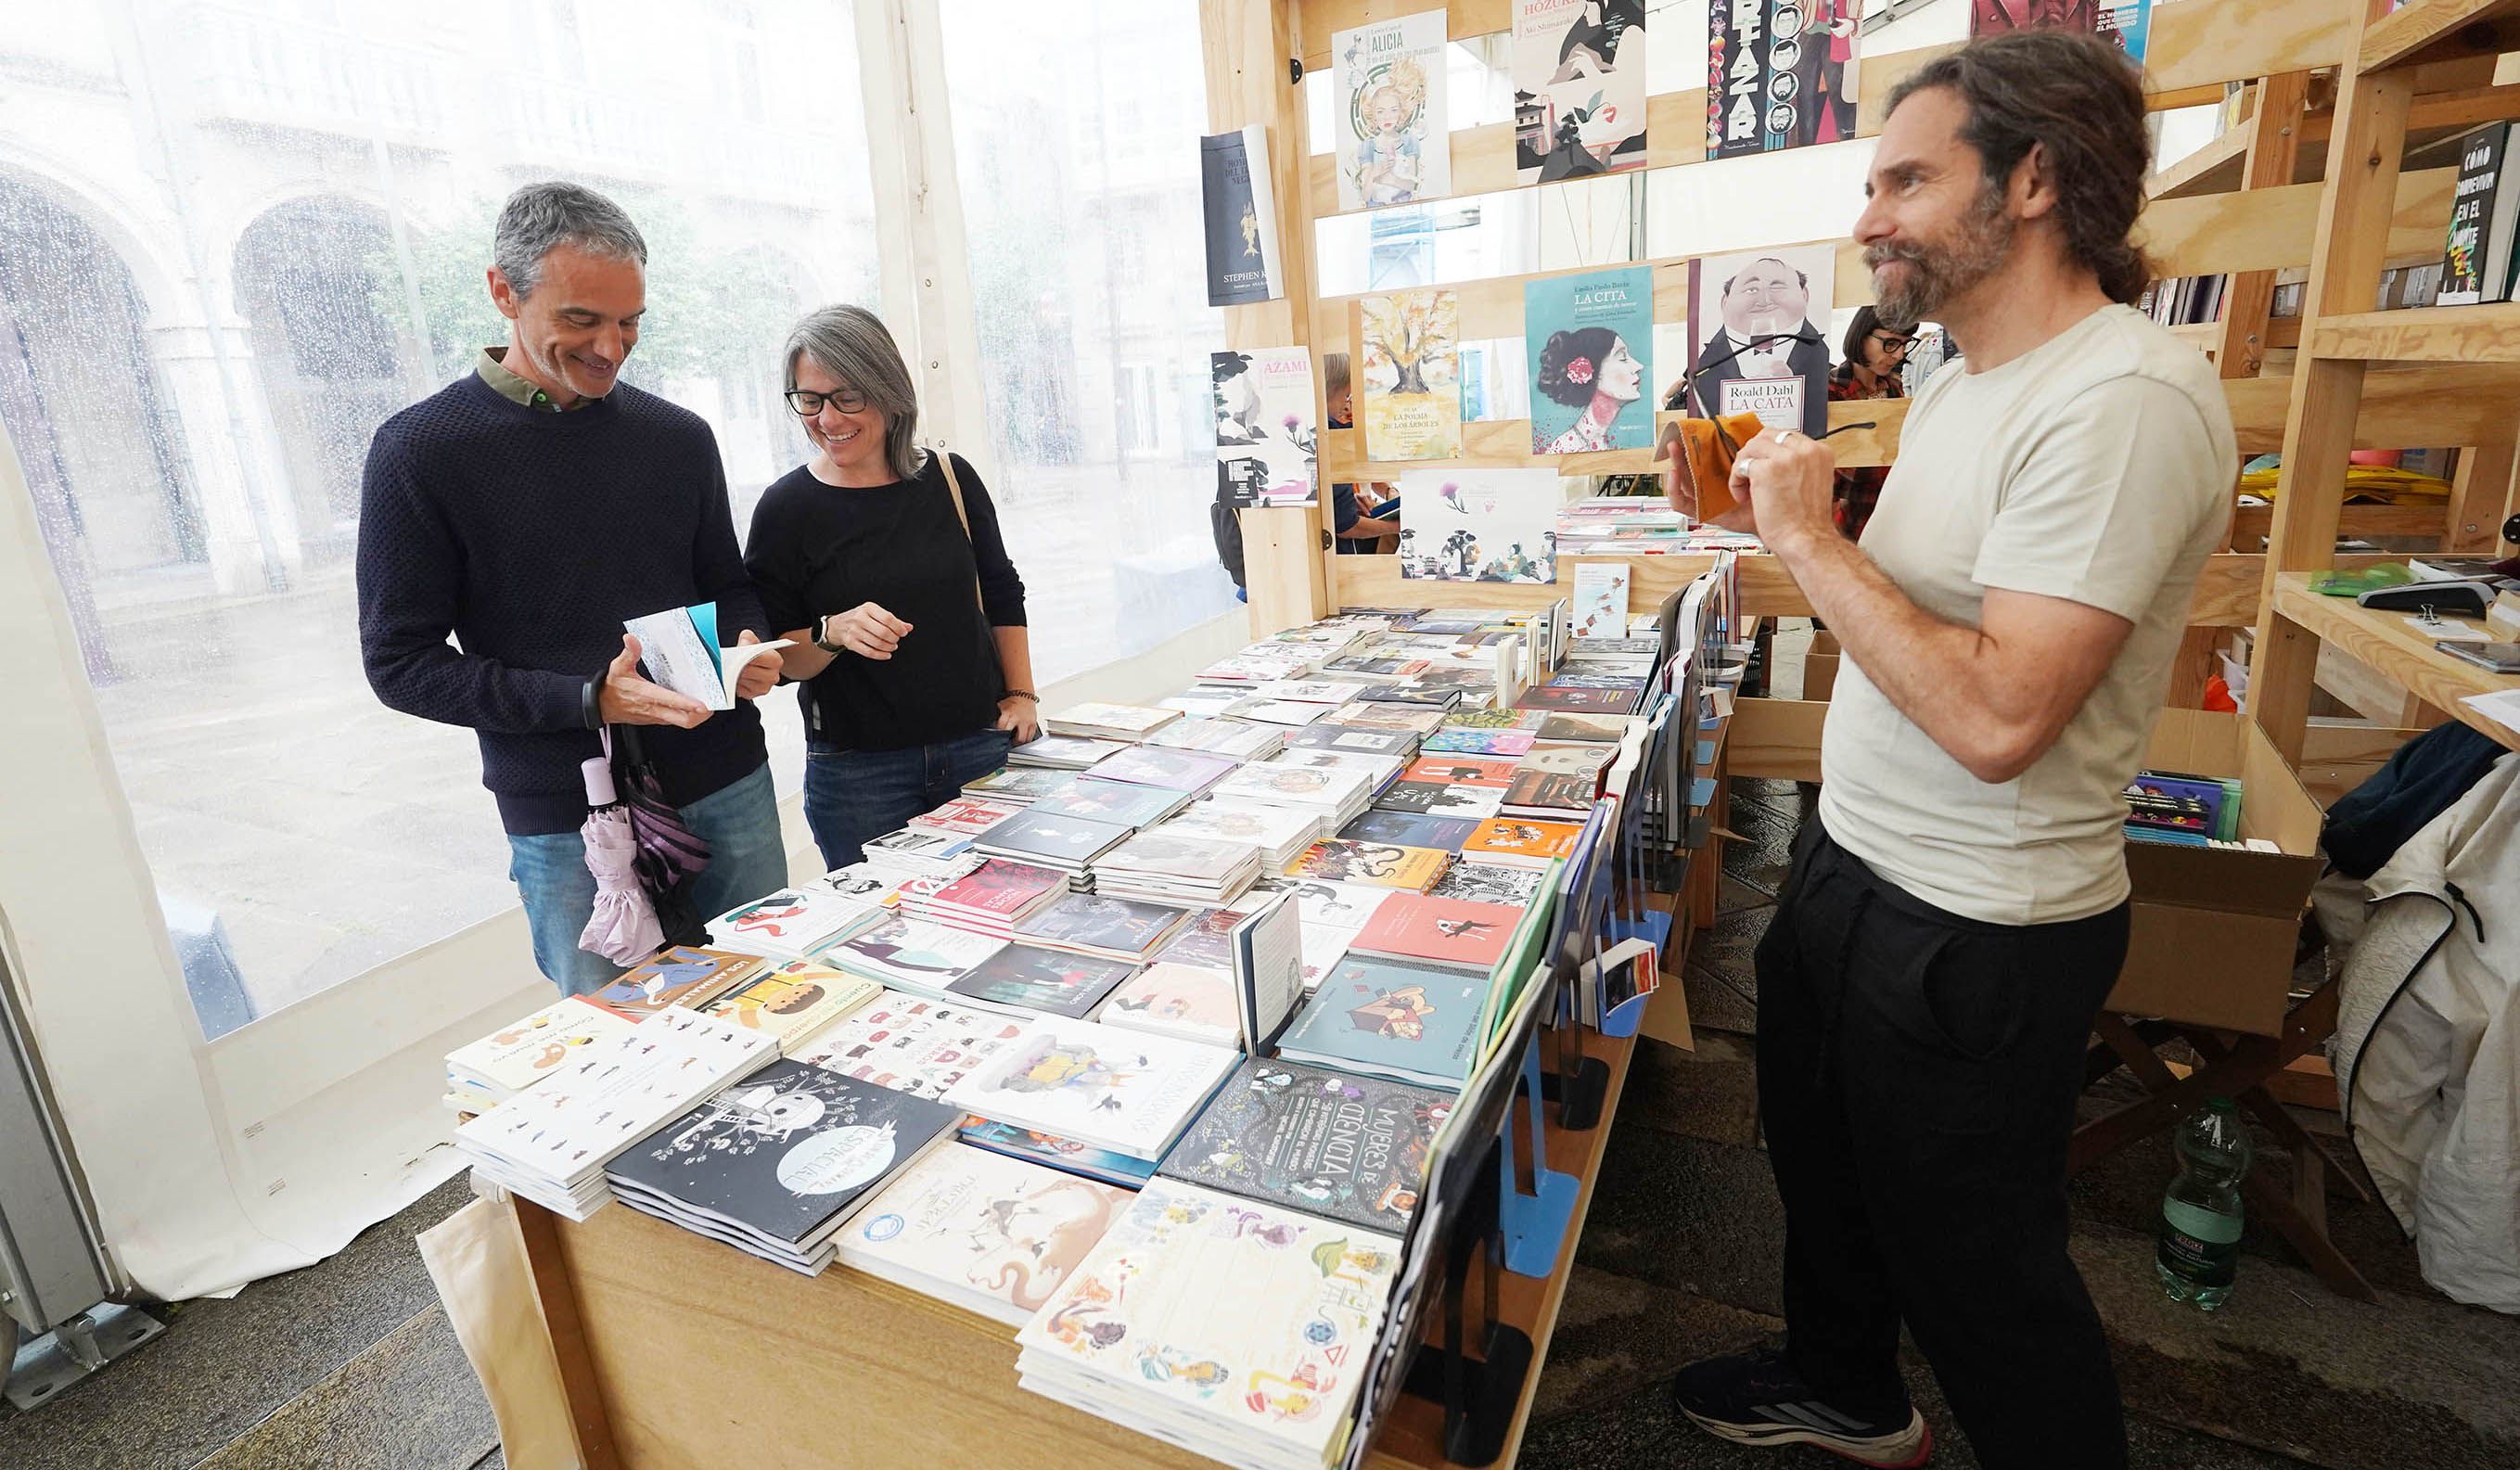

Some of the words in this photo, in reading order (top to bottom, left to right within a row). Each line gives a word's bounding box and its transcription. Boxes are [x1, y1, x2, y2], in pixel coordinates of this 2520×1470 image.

[1372, 31, 1403, 53] ALICIA
[2458, 202, 2469, 223] EN
[2469, 198, 2481, 219] EL
[1223, 271, 1261, 284] STEPHEN
[1574, 294, 1593, 305] LA
[1594, 289, 1628, 303] CITA
[1264, 360, 1308, 374] AZAMI
[1731, 386, 1763, 398] Roald
[1767, 384, 1794, 396] Dahl
[1730, 399, 1749, 411] LA
[1754, 396, 1795, 409] CATA
[1318, 1103, 1365, 1174] CIENCIA
[1362, 1107, 1399, 1170] MUJERES
[1362, 1171, 1377, 1184] DE
